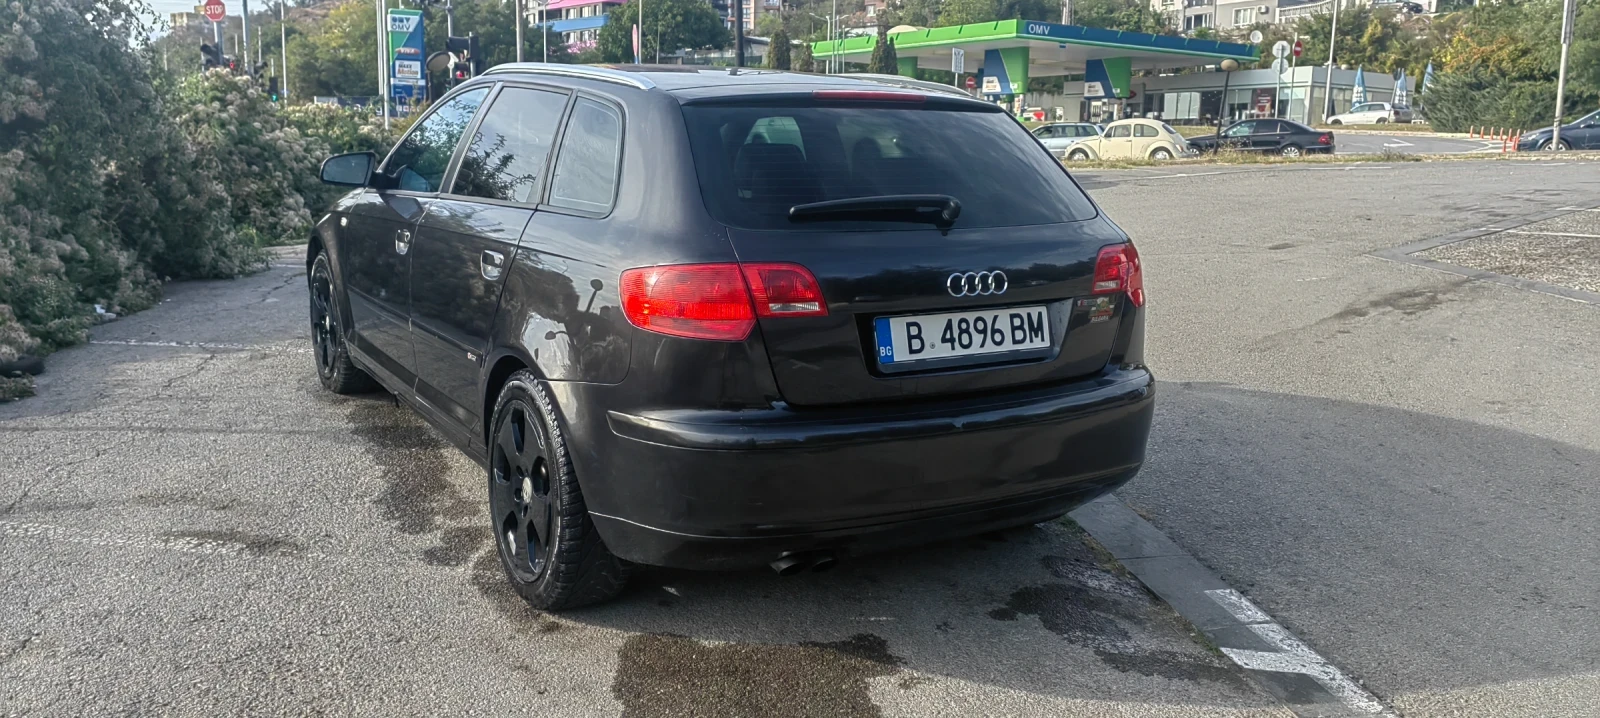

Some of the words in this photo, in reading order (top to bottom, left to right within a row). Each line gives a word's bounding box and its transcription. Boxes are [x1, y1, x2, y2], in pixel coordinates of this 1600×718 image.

[206, 5, 223, 14] STOP
[1028, 24, 1050, 35] OMV
[905, 321, 925, 355] B
[940, 314, 1006, 351] 4896
[1009, 311, 1045, 346] BM
[879, 345, 893, 357] BG
